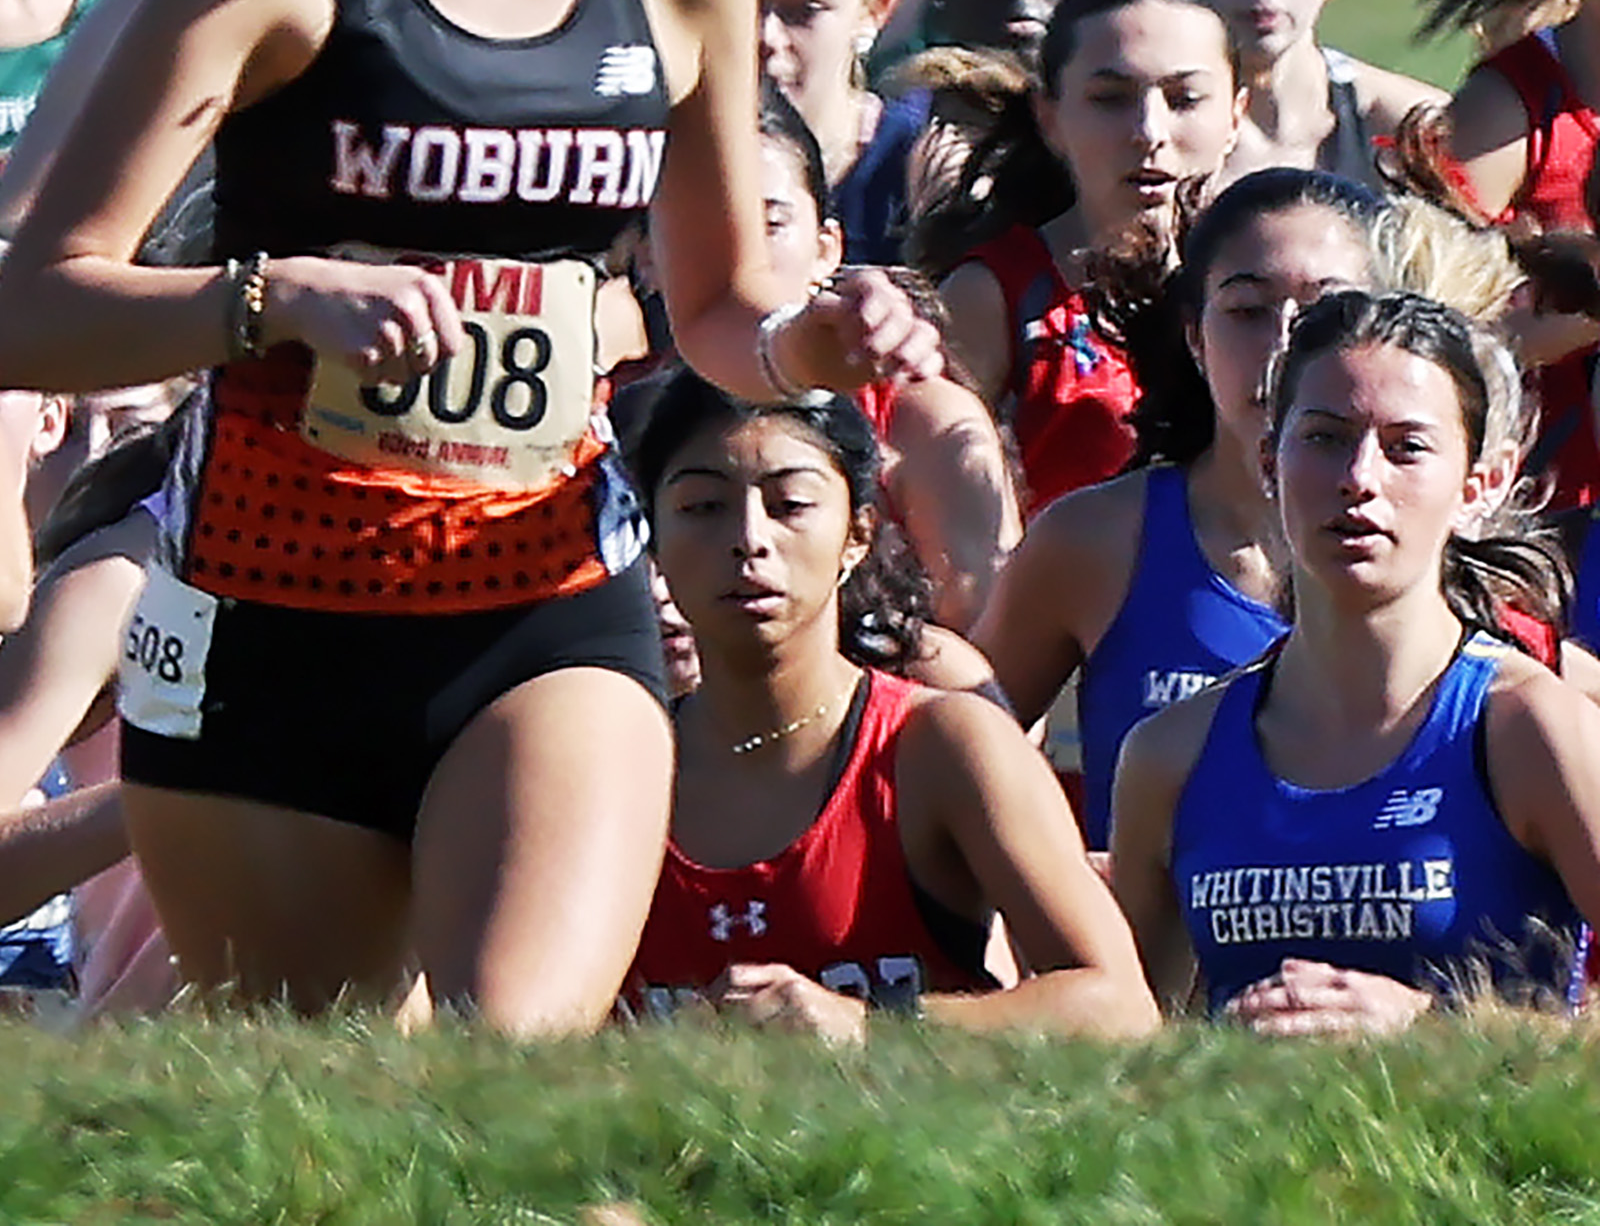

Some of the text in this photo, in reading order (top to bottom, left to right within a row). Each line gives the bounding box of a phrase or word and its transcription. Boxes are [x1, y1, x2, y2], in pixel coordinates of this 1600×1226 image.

[330, 121, 665, 208] WOBURN
[424, 258, 543, 315] MI
[1191, 860, 1454, 909] WHITINSVILLE
[1211, 903, 1413, 943] CHRISTIAN
